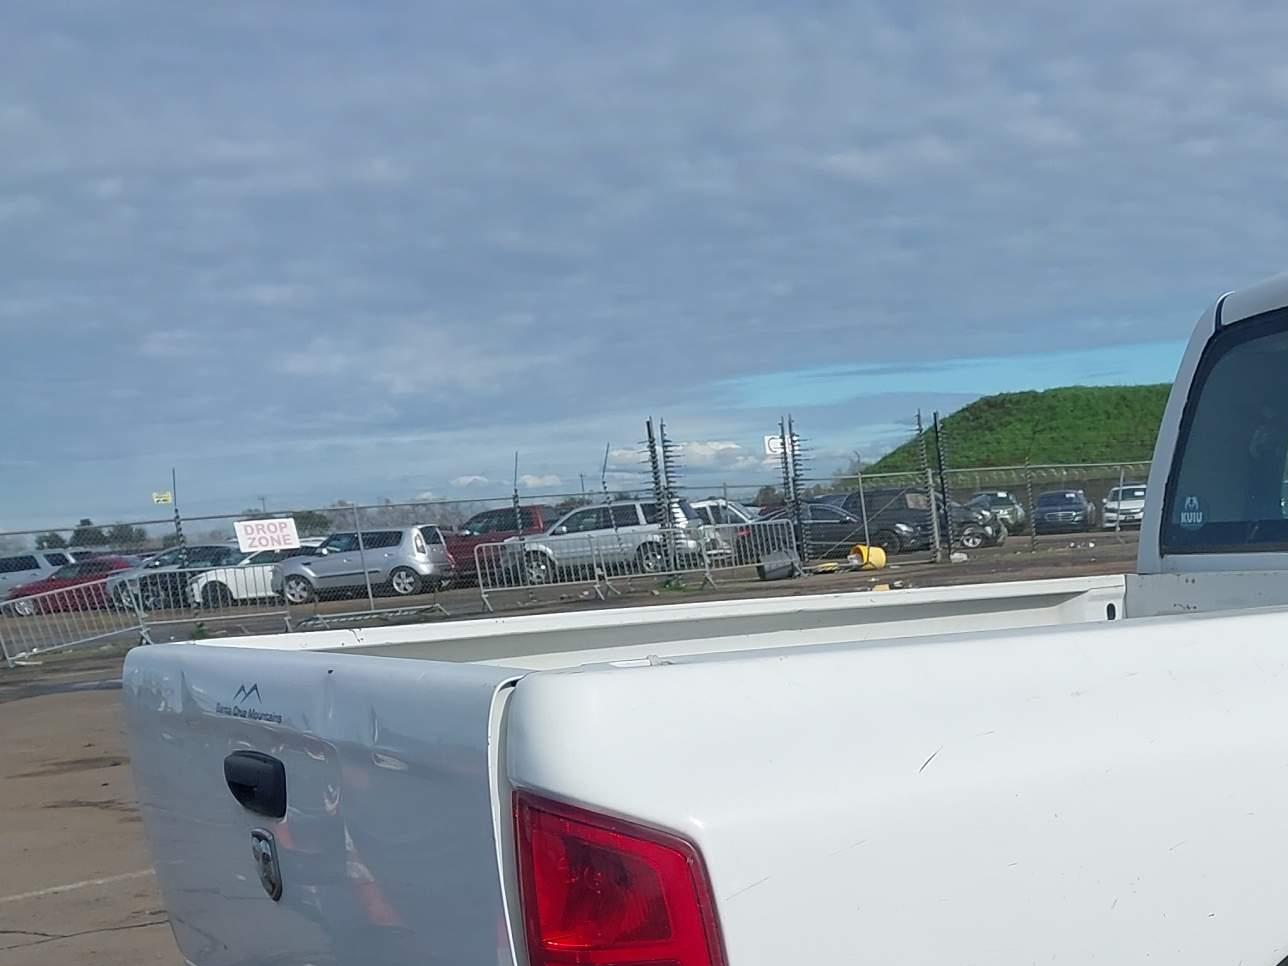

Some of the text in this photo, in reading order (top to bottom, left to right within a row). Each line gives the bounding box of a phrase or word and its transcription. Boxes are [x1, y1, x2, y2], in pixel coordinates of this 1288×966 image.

[1181, 511, 1203, 523] KUIU
[243, 521, 288, 536] DROP
[247, 534, 293, 548] ZONE
